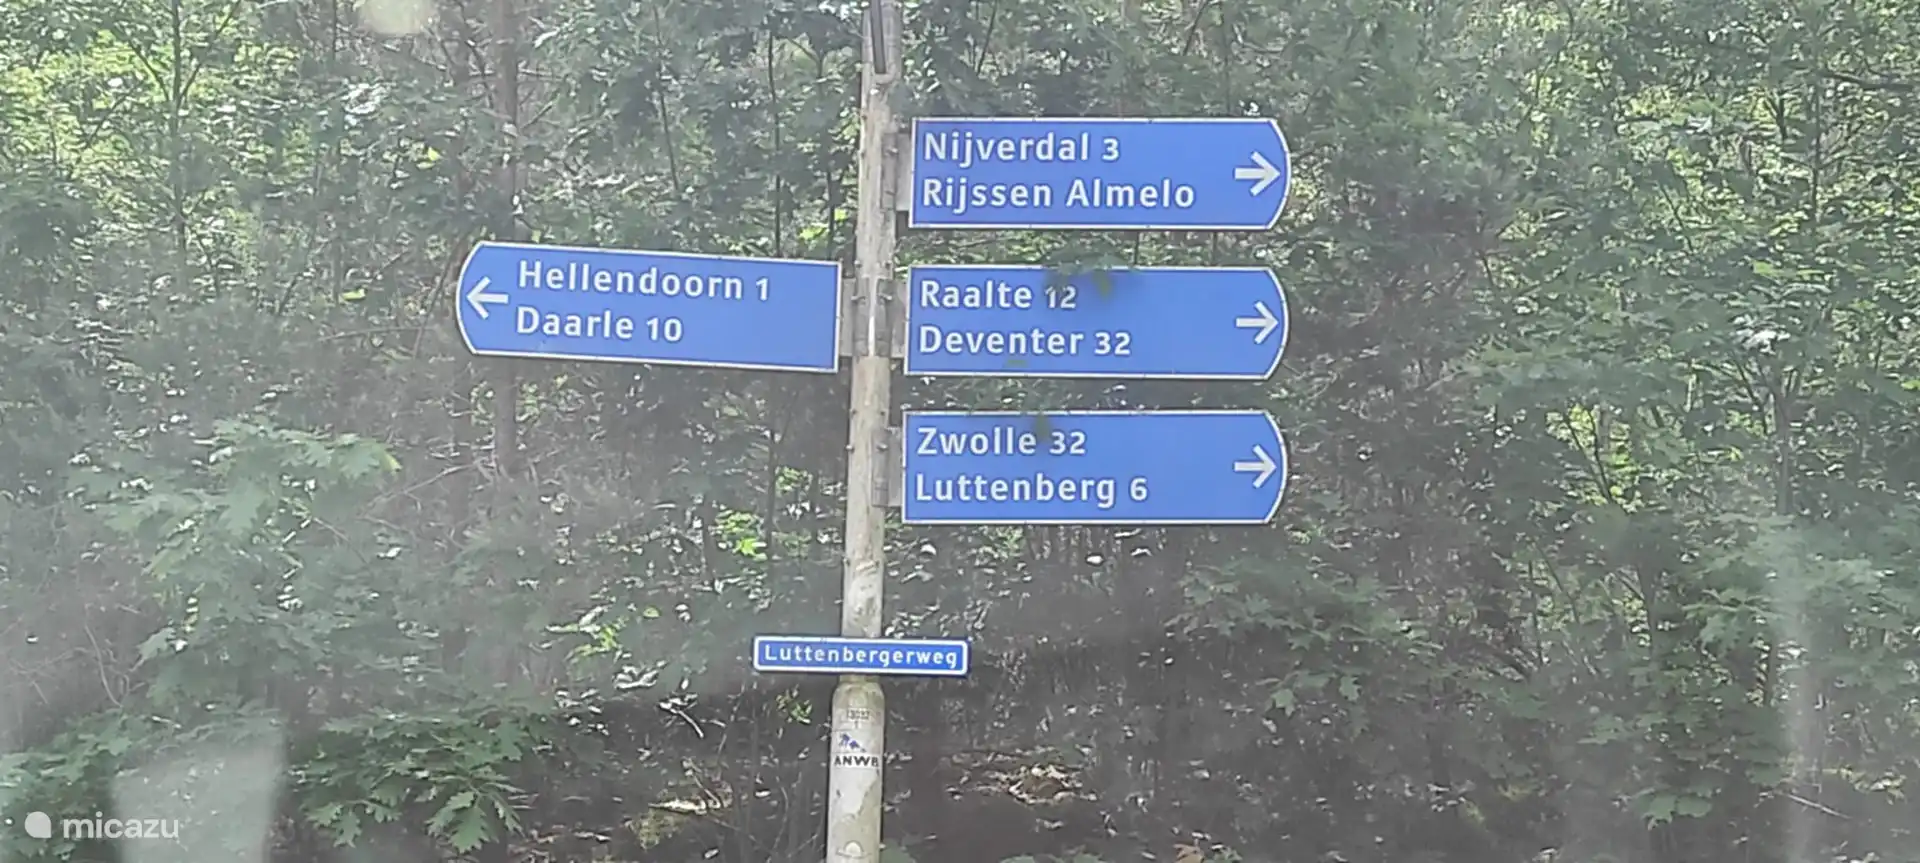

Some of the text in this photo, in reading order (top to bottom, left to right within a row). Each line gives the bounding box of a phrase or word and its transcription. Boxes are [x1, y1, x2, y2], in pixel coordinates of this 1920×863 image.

[923, 132, 1120, 168] Nijverdal 3
[922, 178, 1196, 214] Rijssen Almelo
[518, 259, 770, 301] Hellendoorn 1
[920, 280, 1077, 309] Raalte 12
[516, 306, 683, 342] Daarle 10
[919, 325, 1131, 355] Deventer 32
[917, 427, 1086, 455] Zwolle 32
[916, 473, 1149, 509] Luttenberg 6
[765, 644, 957, 669] Luttenbergerweg
[834, 755, 880, 768] ANWB
